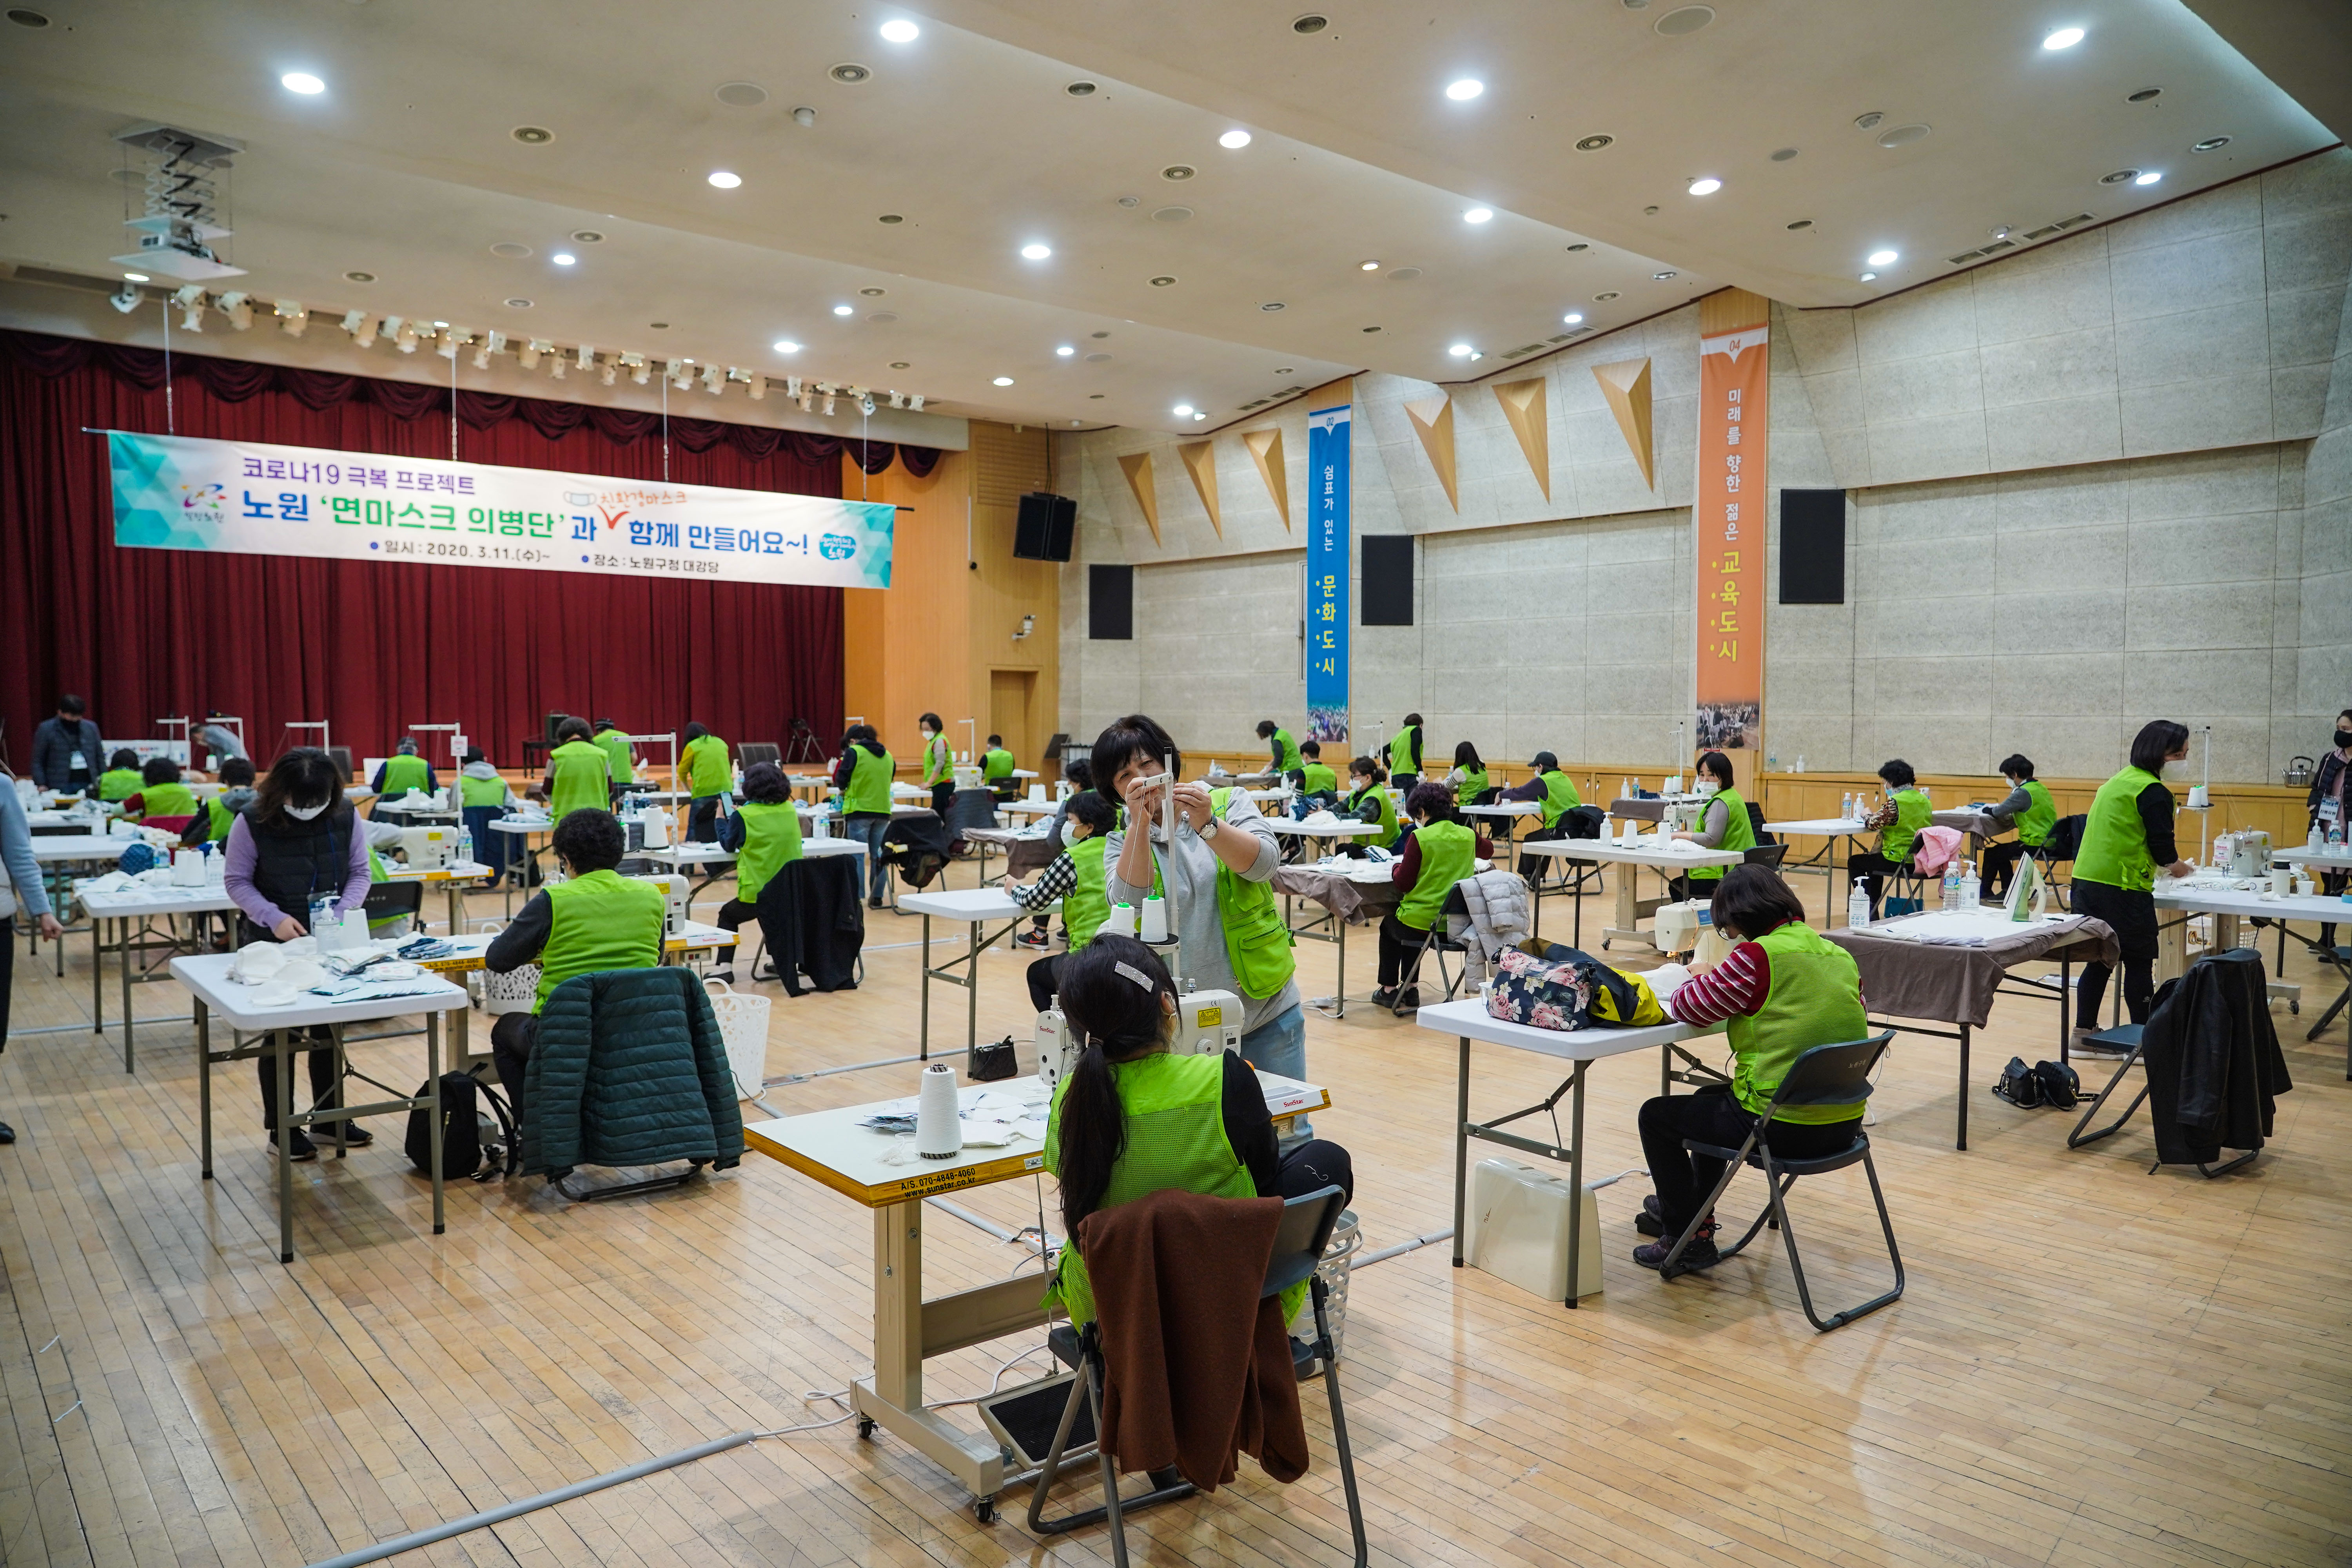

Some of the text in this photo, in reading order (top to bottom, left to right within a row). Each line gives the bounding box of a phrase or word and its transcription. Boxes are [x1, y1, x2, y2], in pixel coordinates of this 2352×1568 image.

[1729, 339, 1741, 352] 04
[1327, 417, 1334, 426] 02
[243, 458, 475, 494] 코로나19 극복 프로젝트
[1725, 388, 1742, 541] 미래를 향한 젊은
[243, 490, 309, 521] 노원
[629, 521, 679, 548] 함께
[1324, 465, 1334, 551] 쉼표가 있는
[684, 560, 719, 573] 대강당
[1719, 551, 1740, 662] 교육도시
[1322, 575, 1336, 676] 문화도시
[1039, 1025, 1055, 1034] SunStar
[1283, 1099, 1304, 1107] SunStar
[901, 1168, 976, 1191] A/S. 070-4848-4060
[904, 1177, 975, 1198] www.sunstar.co.kr
